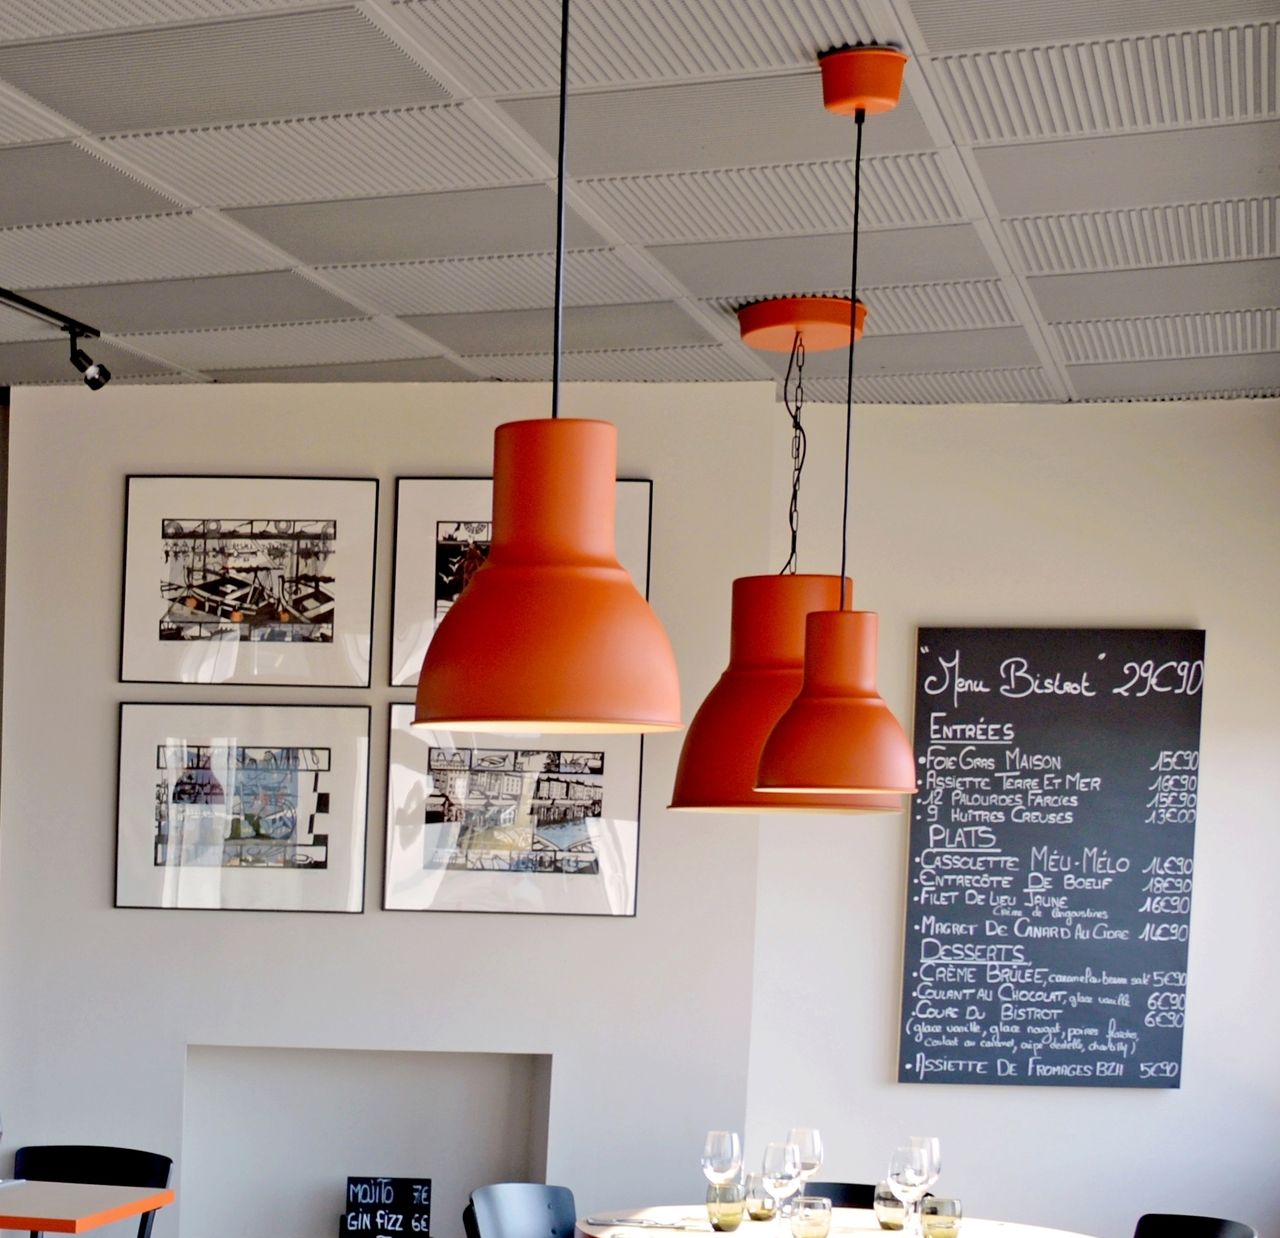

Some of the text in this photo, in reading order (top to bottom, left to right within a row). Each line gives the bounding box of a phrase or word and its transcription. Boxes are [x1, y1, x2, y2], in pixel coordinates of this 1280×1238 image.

[1005, 747, 1062, 770] MAISON
[1150, 750, 1200, 772] 15€90
[1065, 772, 1101, 791] MER
[1148, 774, 1197, 792] 16€90
[922, 789, 944, 805] 12
[1146, 792, 1197, 808] 15€90
[927, 805, 939, 822] 9
[1145, 808, 1197, 825] 13€00
[929, 823, 997, 849] PLATS
[1063, 874, 1113, 890] BOEUF
[1142, 877, 1193, 894] 18€90
[920, 887, 960, 905] FILET
[1138, 896, 1191, 914] 16€90
[1028, 1056, 1094, 1077] FROMAGES
[412, 1184, 430, 1205] 7€
[411, 1213, 429, 1232] 6€
